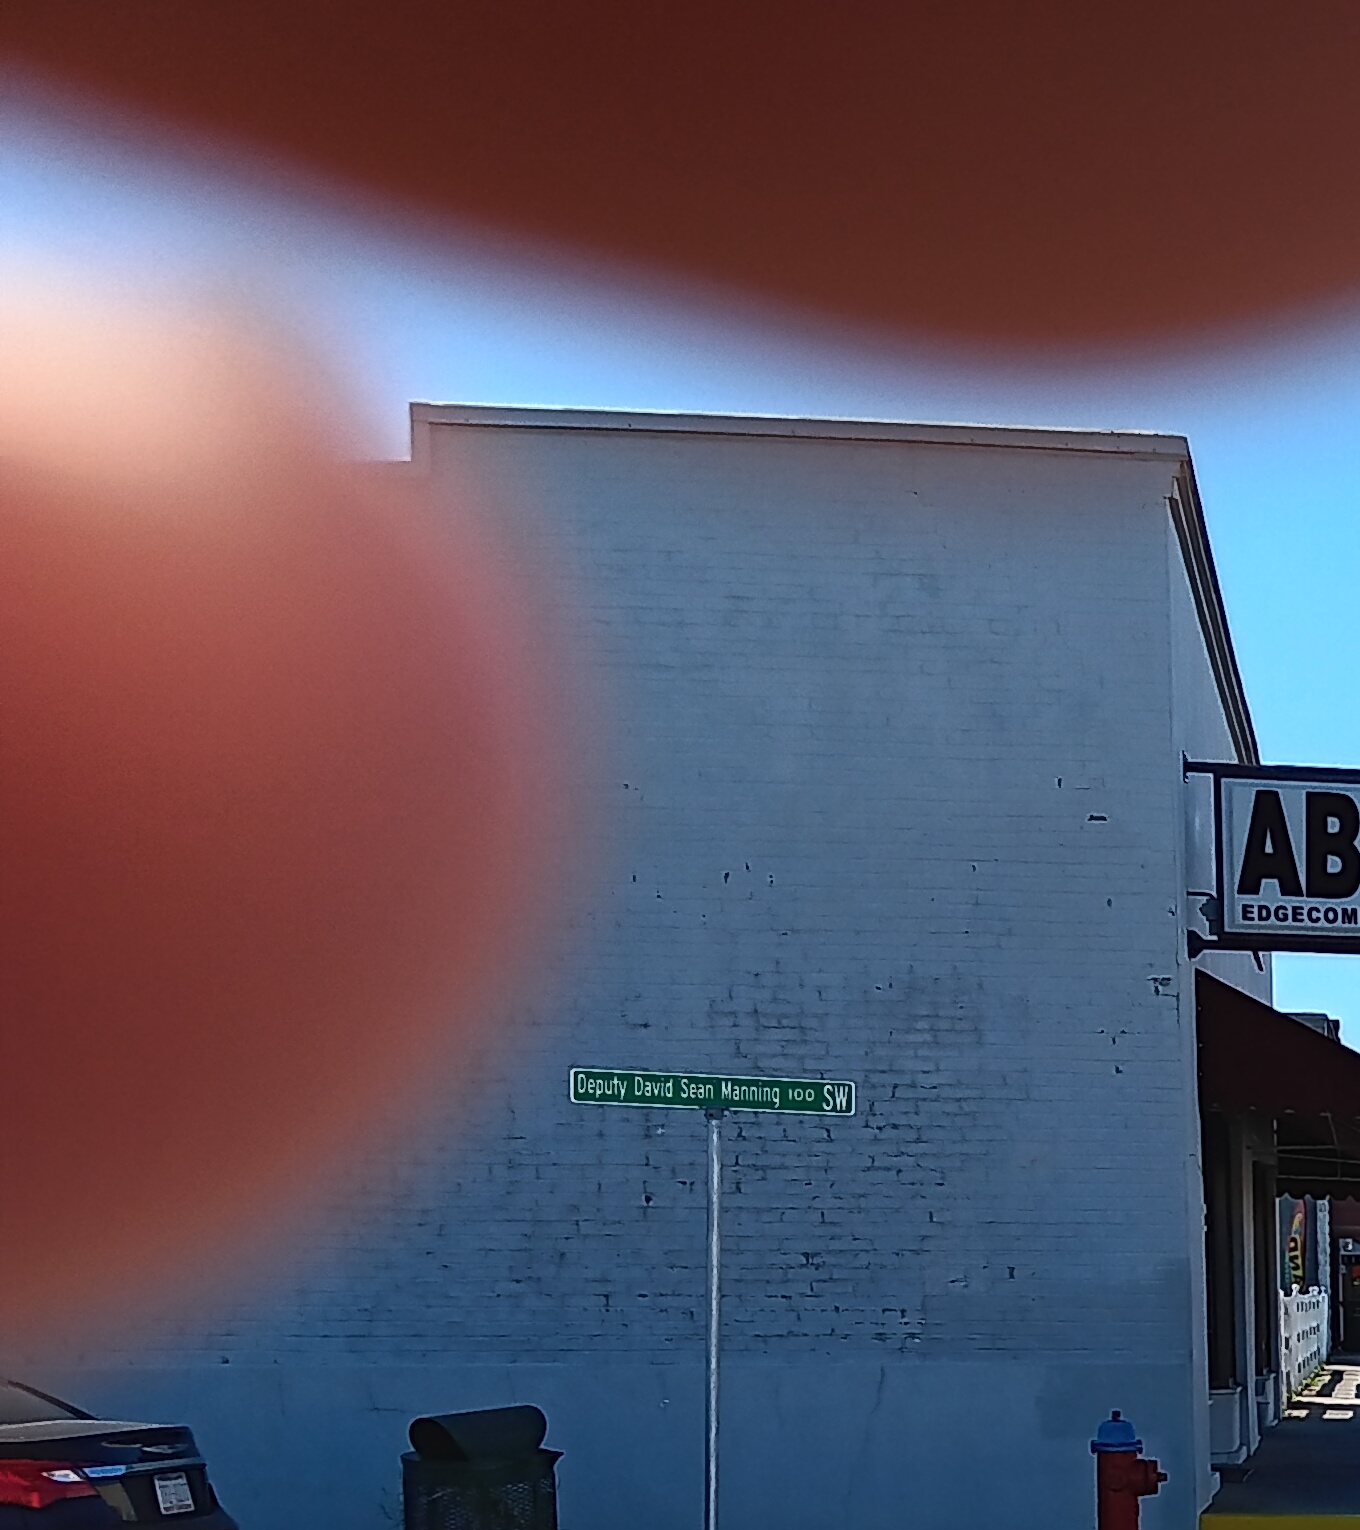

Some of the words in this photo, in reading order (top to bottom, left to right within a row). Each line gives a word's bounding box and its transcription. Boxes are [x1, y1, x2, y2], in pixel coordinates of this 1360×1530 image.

[577, 1073, 627, 1100] Deputy
[634, 1076, 673, 1099] David
[680, 1079, 714, 1100] Sean
[721, 1080, 780, 1109] Manning
[788, 1088, 815, 1102] 100
[822, 1085, 849, 1111] SW
